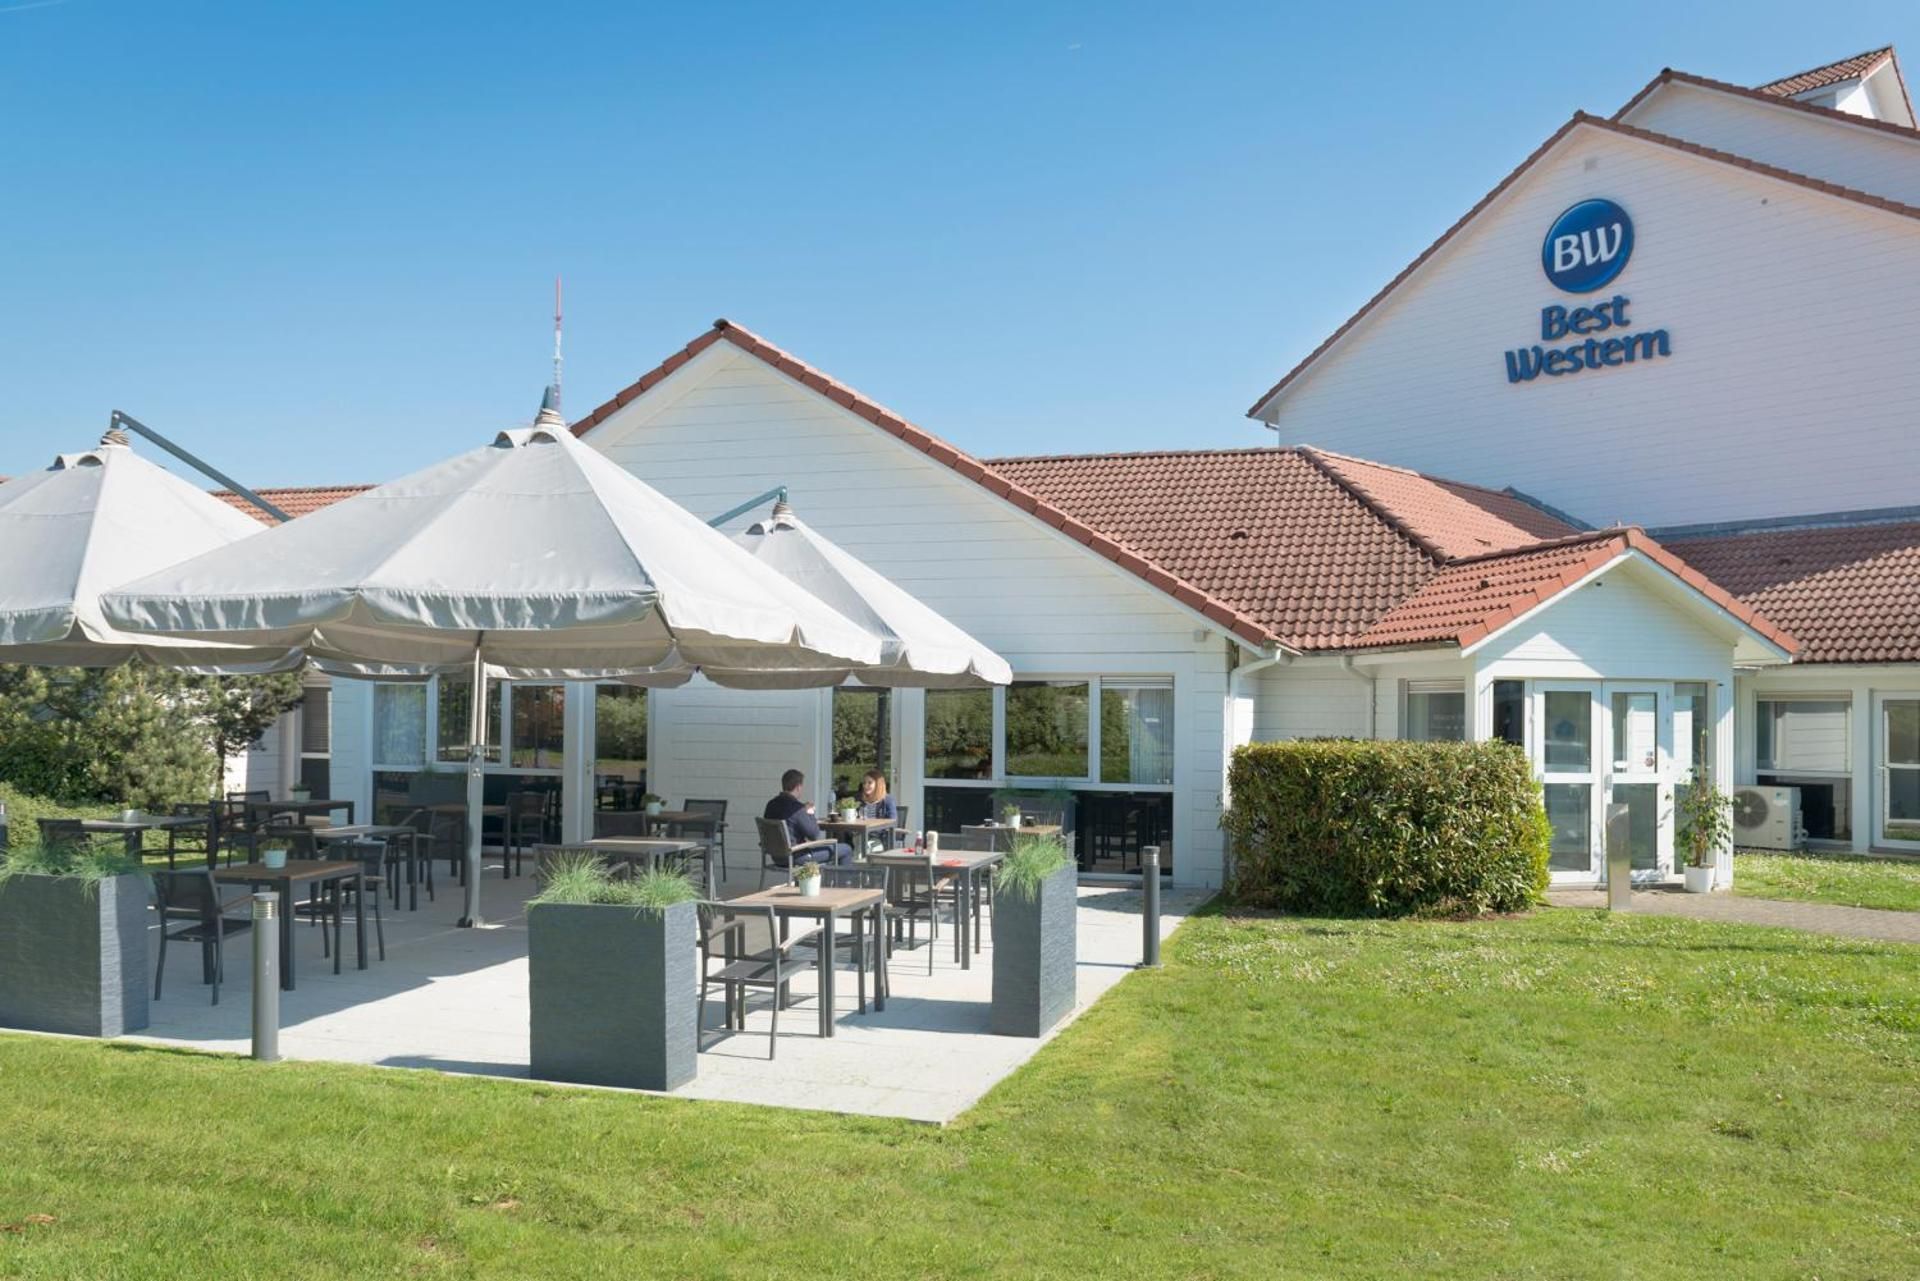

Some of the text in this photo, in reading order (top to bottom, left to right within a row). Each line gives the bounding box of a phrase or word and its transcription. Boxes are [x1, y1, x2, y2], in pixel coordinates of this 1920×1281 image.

[1554, 223, 1623, 273] BW
[1541, 295, 1631, 341] Best
[1504, 329, 1672, 383] Western
